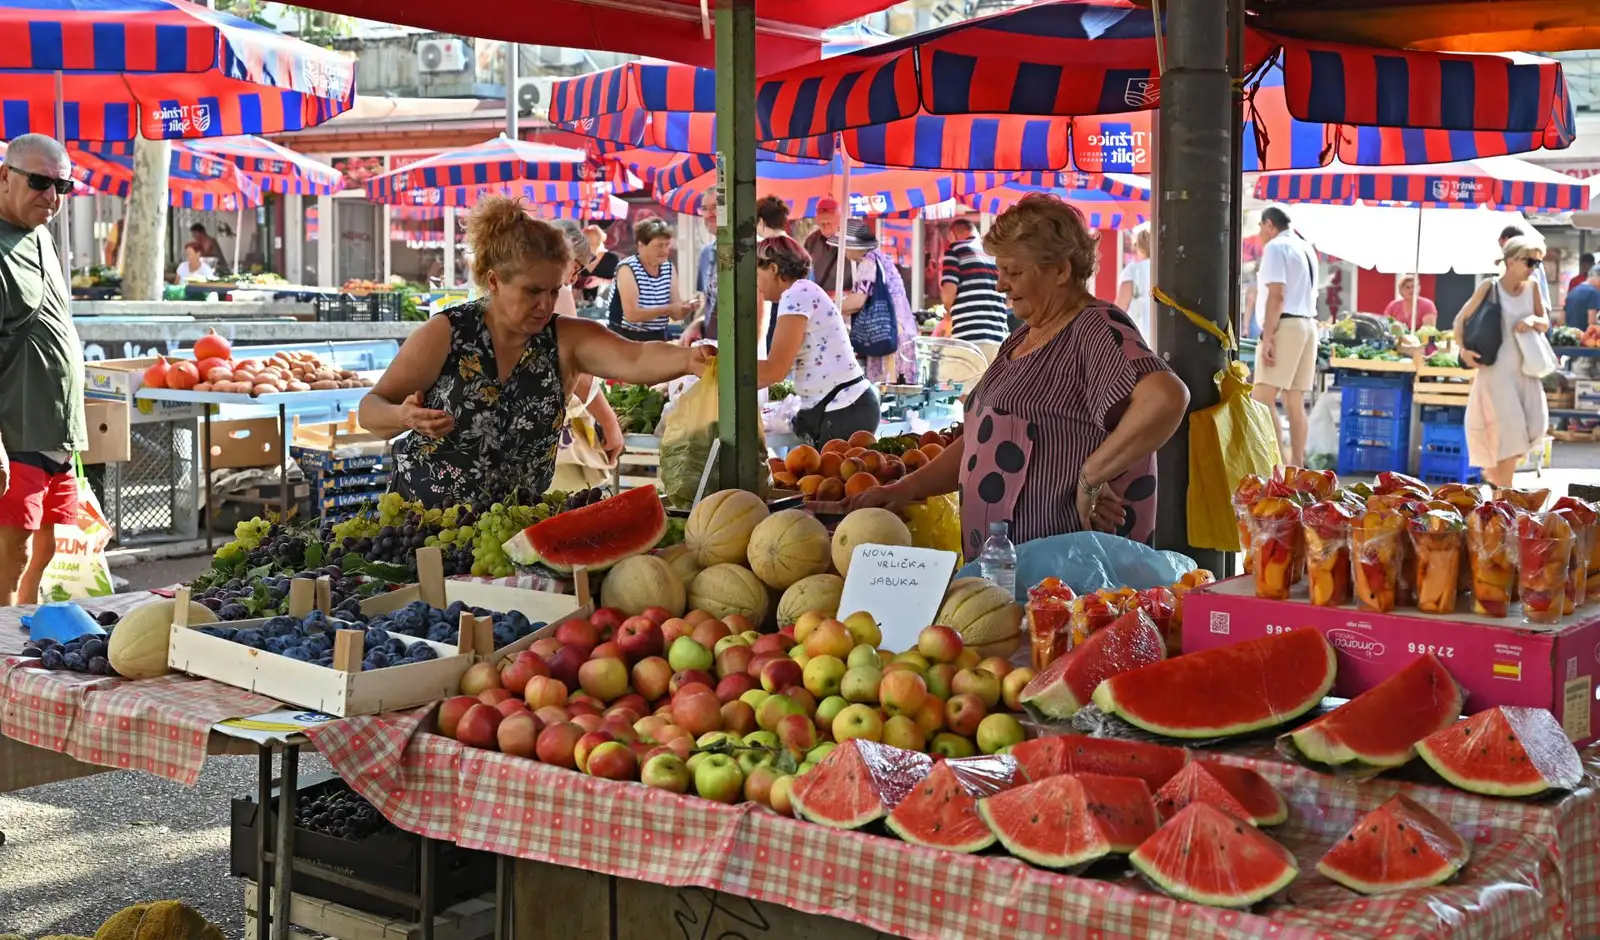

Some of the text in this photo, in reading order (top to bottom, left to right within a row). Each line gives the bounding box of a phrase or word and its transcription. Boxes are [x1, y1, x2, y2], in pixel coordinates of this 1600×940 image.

[1450, 180, 1484, 191] Tržnice
[1450, 190, 1470, 201] Split
[862, 548, 894, 557] NOVA
[877, 558, 926, 569] VRLIČKA
[870, 577, 919, 587] JABUKA
[1335, 638, 1385, 656] Comarca
[1407, 642, 1454, 658] 27366
